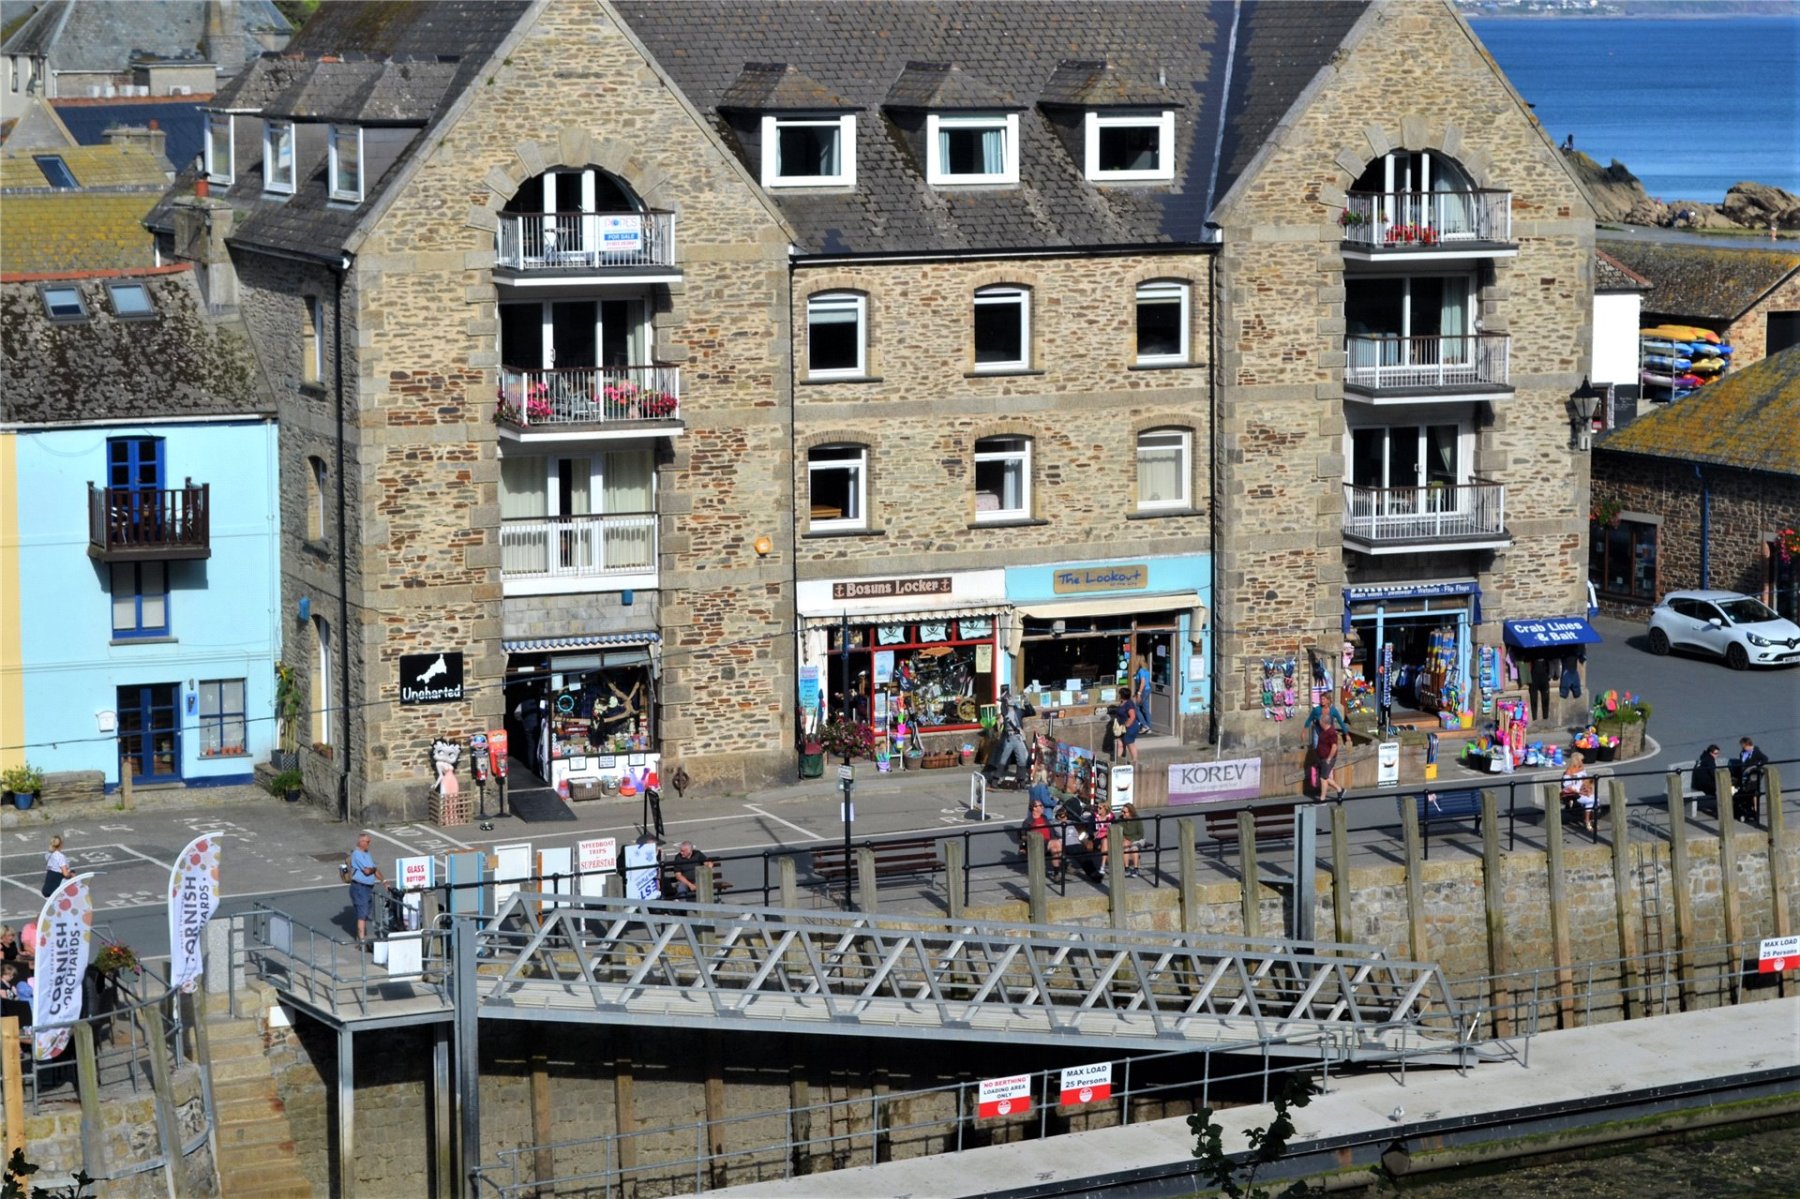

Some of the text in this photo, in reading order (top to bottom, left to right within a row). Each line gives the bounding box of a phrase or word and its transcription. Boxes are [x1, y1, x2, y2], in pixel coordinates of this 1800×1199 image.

[1058, 570, 1142, 585] The Lookout
[846, 579, 939, 597] Bosuns Locker
[1444, 585, 1454, 593] Flip
[1456, 583, 1470, 592] Flops
[1514, 622, 1583, 633] Crab Lines
[1536, 631, 1578, 642] & Bait
[403, 684, 461, 701] Uncharted
[1181, 763, 1247, 785] KOREV
[581, 840, 614, 849] SPEEDBOAT
[406, 865, 425, 873] GLASS
[580, 858, 615, 870] SUPERSTAR
[1780, 938, 1798, 946] LOAD
[49, 923, 68, 1015] CORNISH
[1067, 1065, 1107, 1077] MAX LOAD
[995, 1077, 1026, 1087] BERTHING
[1077, 1077, 1107, 1086] Persons
[983, 1084, 1026, 1095] LOADING AREA
